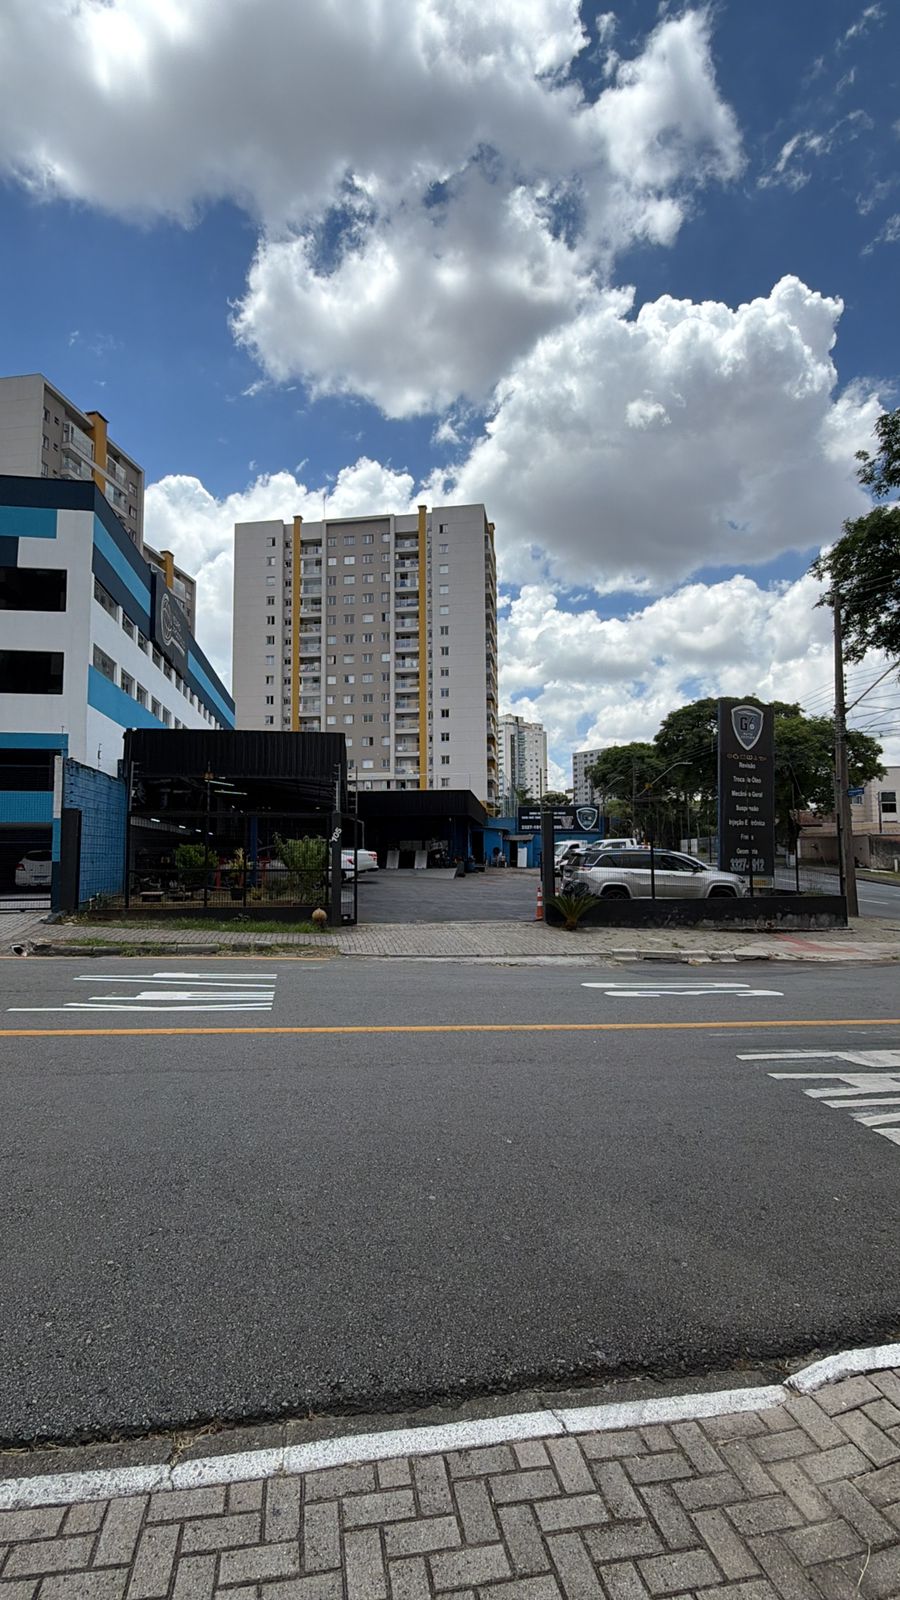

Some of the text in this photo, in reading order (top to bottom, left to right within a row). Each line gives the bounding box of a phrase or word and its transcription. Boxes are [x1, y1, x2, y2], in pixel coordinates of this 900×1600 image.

[731, 790, 751, 798] Mecânia
[736, 847, 758, 855] Geomria
[729, 857, 765, 872] 3327-912
